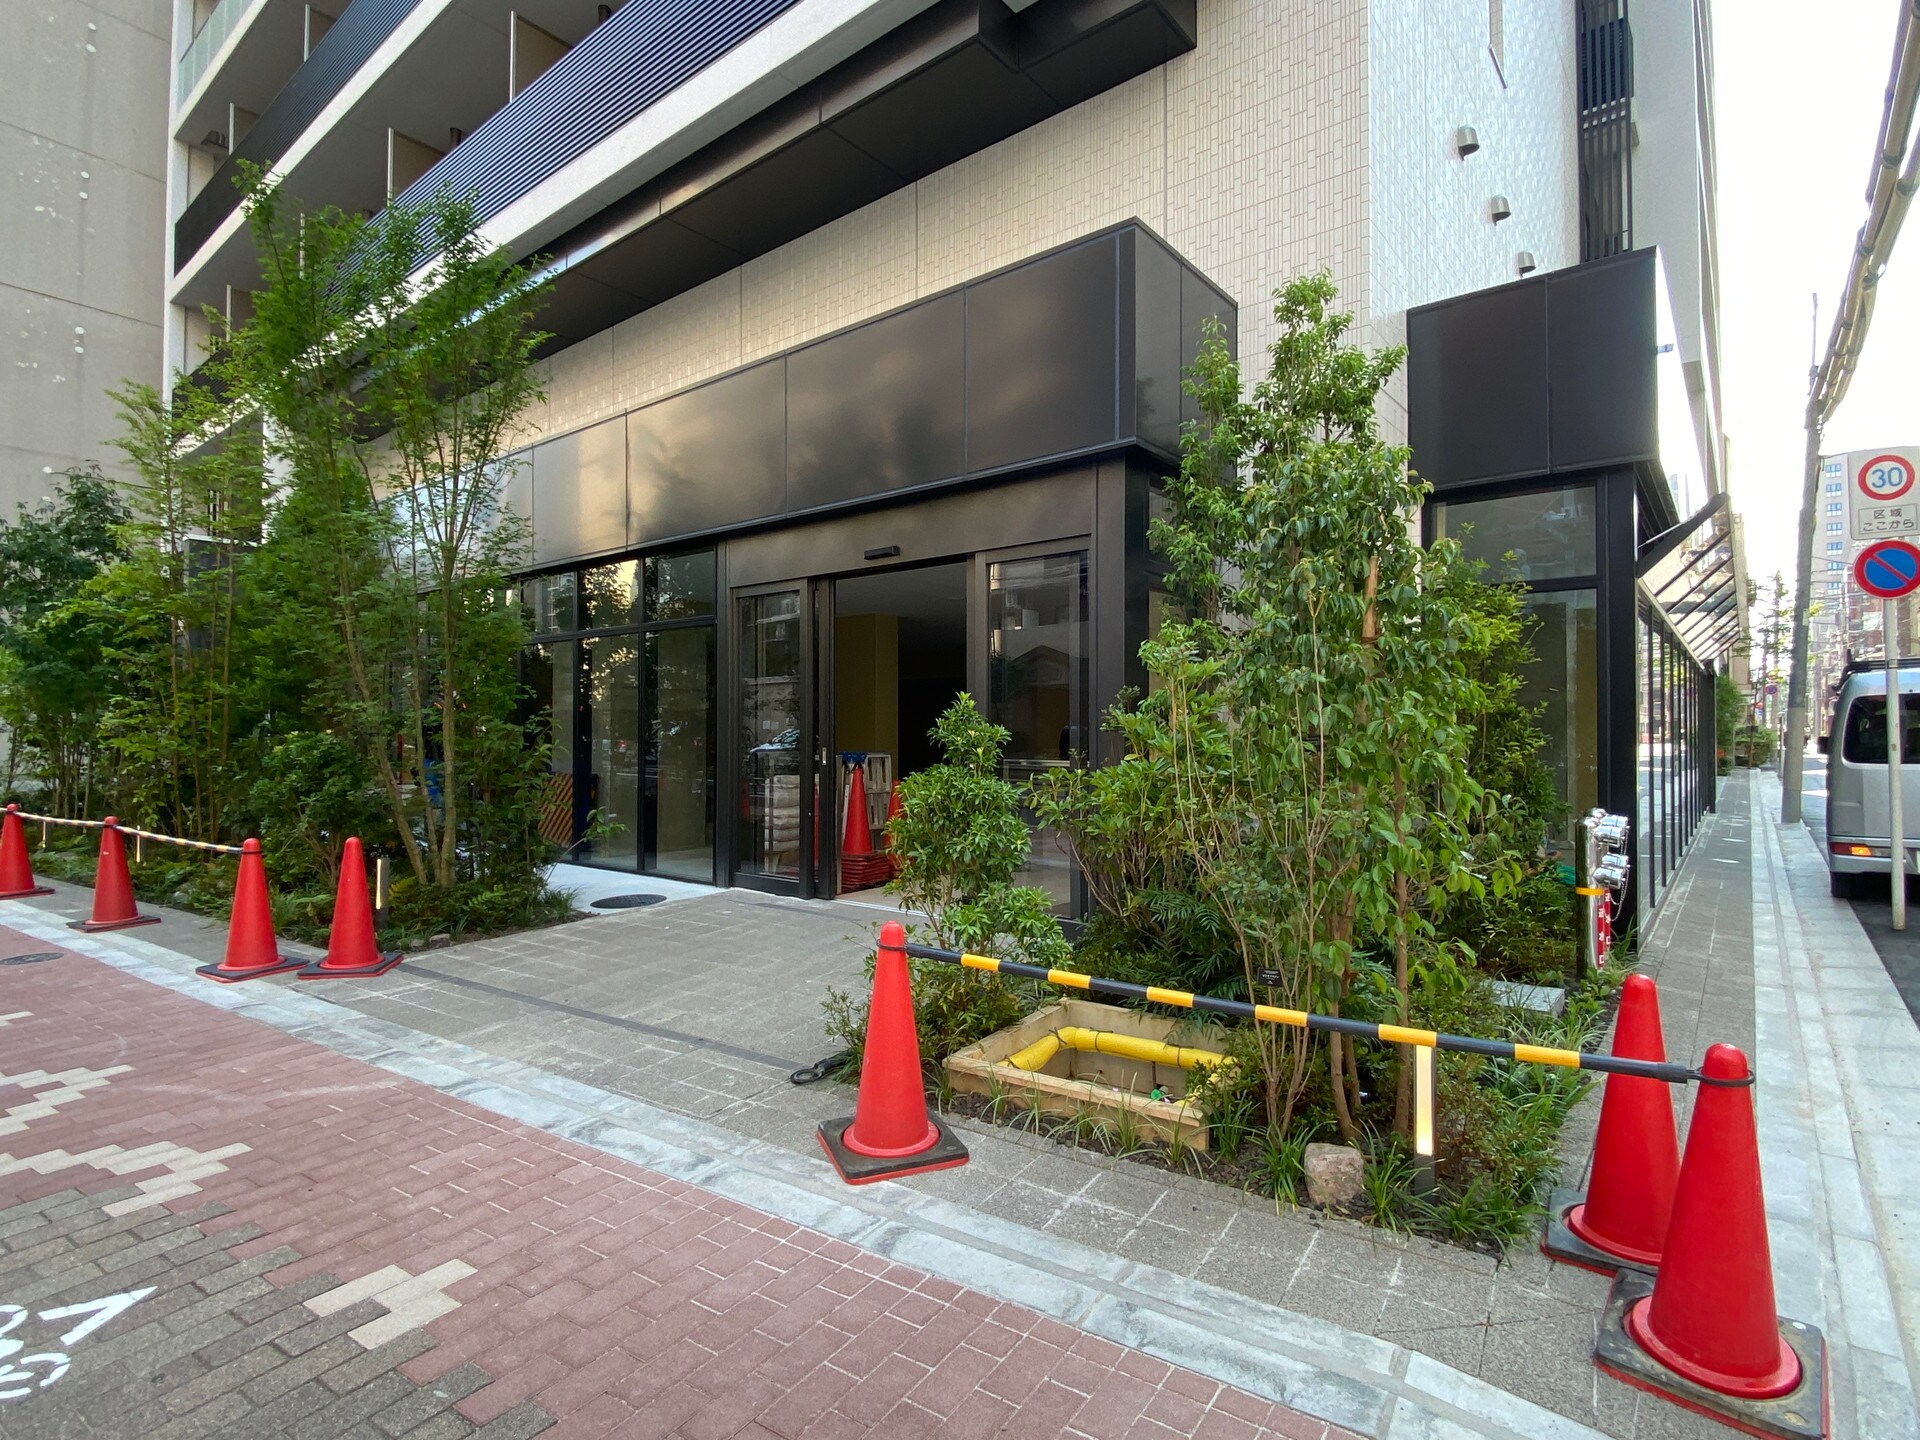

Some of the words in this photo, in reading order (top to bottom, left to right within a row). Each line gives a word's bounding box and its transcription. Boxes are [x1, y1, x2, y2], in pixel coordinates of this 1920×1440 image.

[1871, 467, 1903, 488] 30
[1873, 508, 1902, 519] 区域
[1863, 519, 1914, 532] ここから
